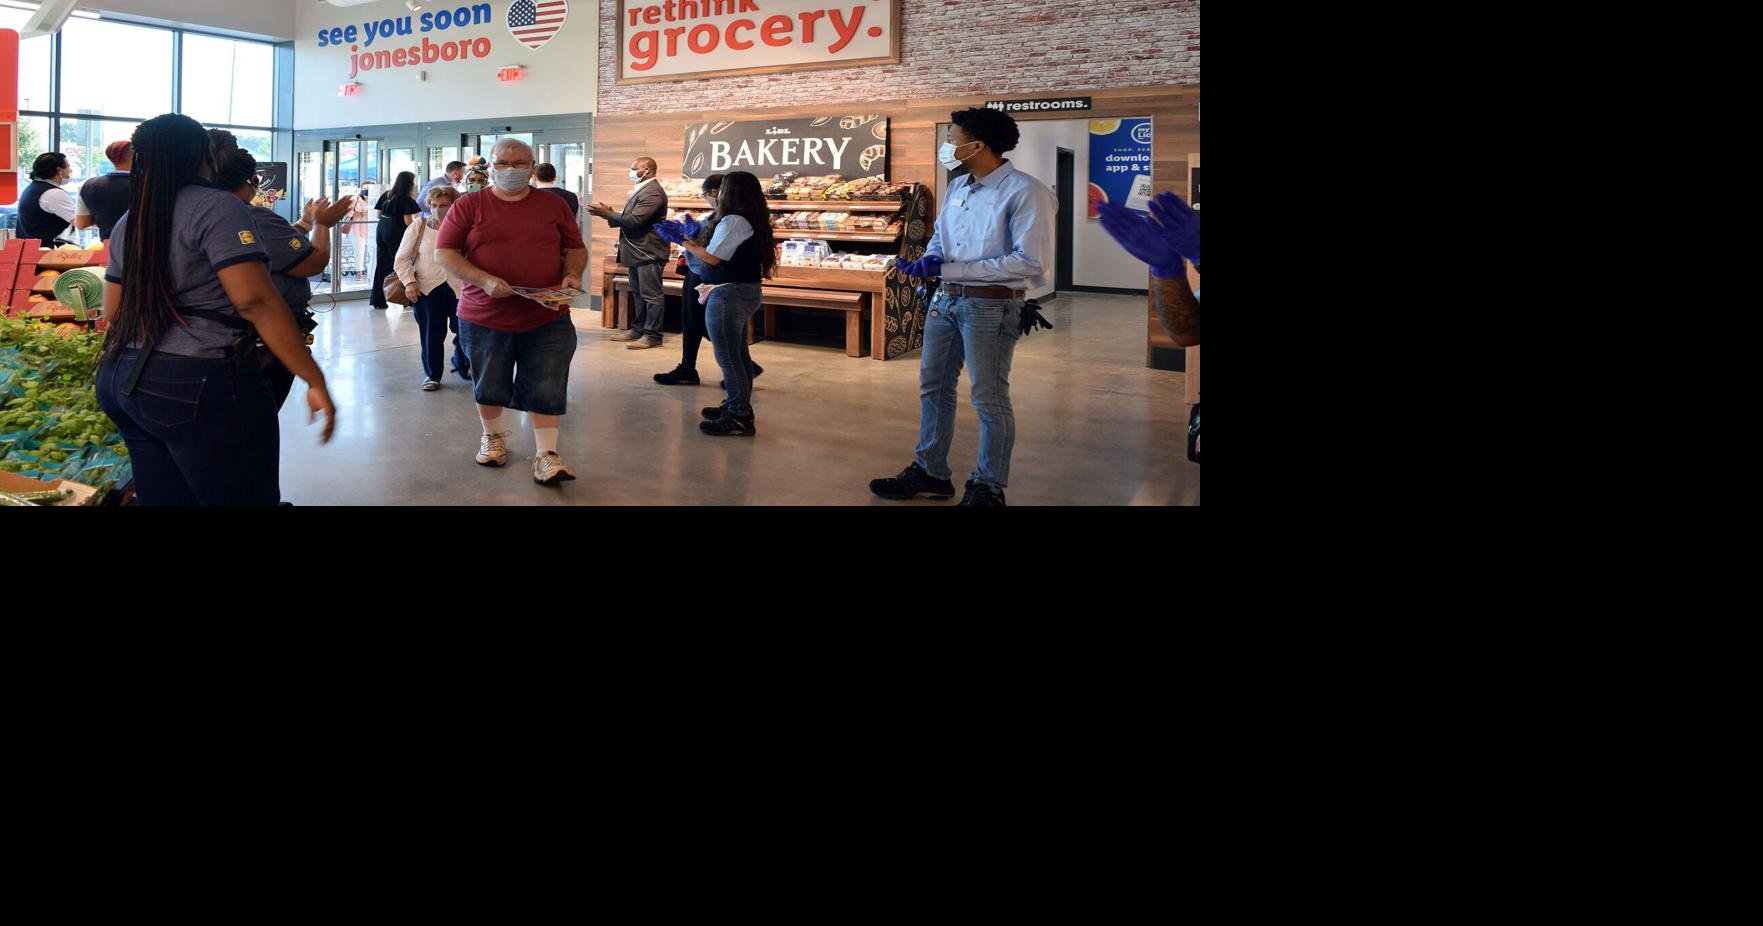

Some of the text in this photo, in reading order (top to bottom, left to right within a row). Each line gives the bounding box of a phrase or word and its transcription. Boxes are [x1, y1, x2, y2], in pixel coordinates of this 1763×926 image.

[318, 2, 492, 48] see you soon
[628, 5, 882, 72] grocery.
[349, 37, 492, 79] jonesboro
[1006, 99, 1089, 111] restrooms.
[709, 137, 853, 171] BAKERY
[1105, 153, 1151, 162] downlo
[1105, 165, 1129, 173] app
[1131, 163, 1140, 171] &
